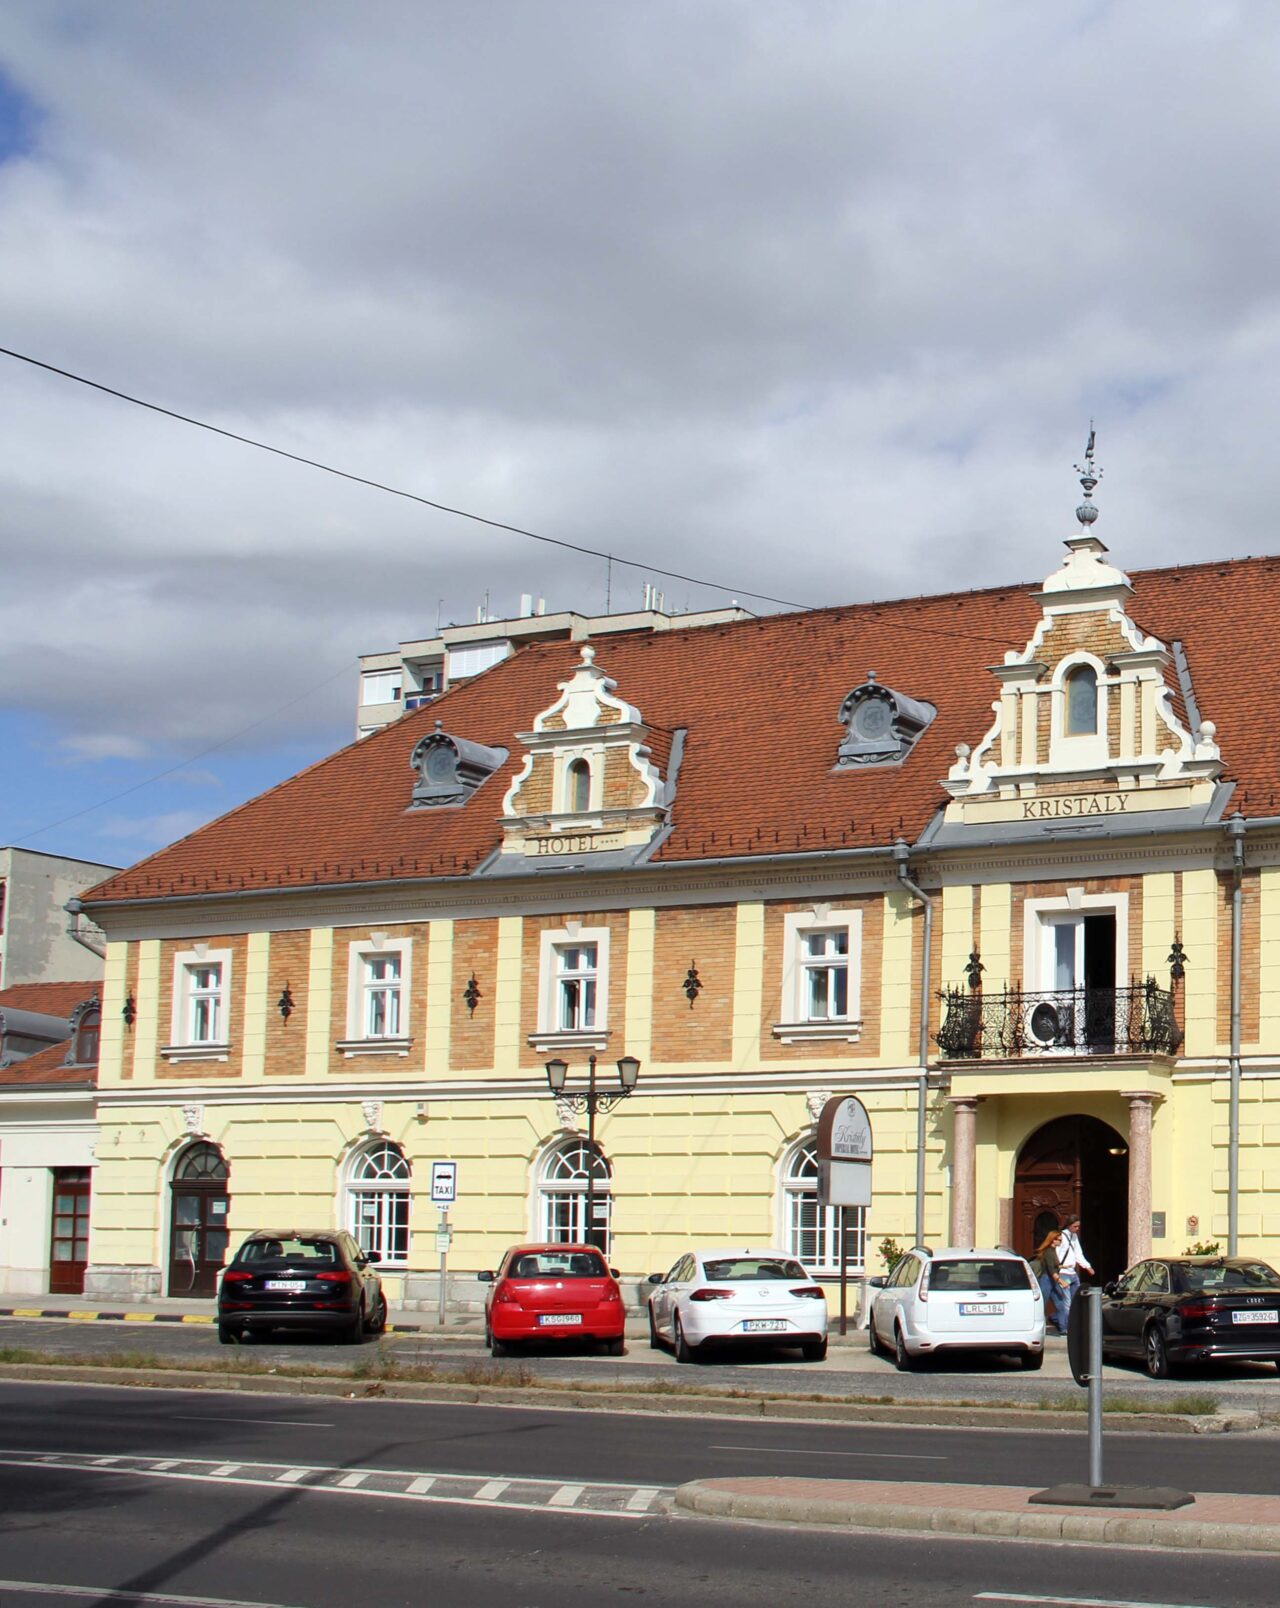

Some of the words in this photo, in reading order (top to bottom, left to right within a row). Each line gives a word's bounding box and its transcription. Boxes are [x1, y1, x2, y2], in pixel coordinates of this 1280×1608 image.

[1022, 792, 1129, 818] KRISTÁLY
[537, 834, 598, 854] HOTEL
[435, 1186, 453, 1195] TAXI
[965, 1304, 1003, 1313] LRL-184
[749, 1321, 784, 1329] PKW-721
